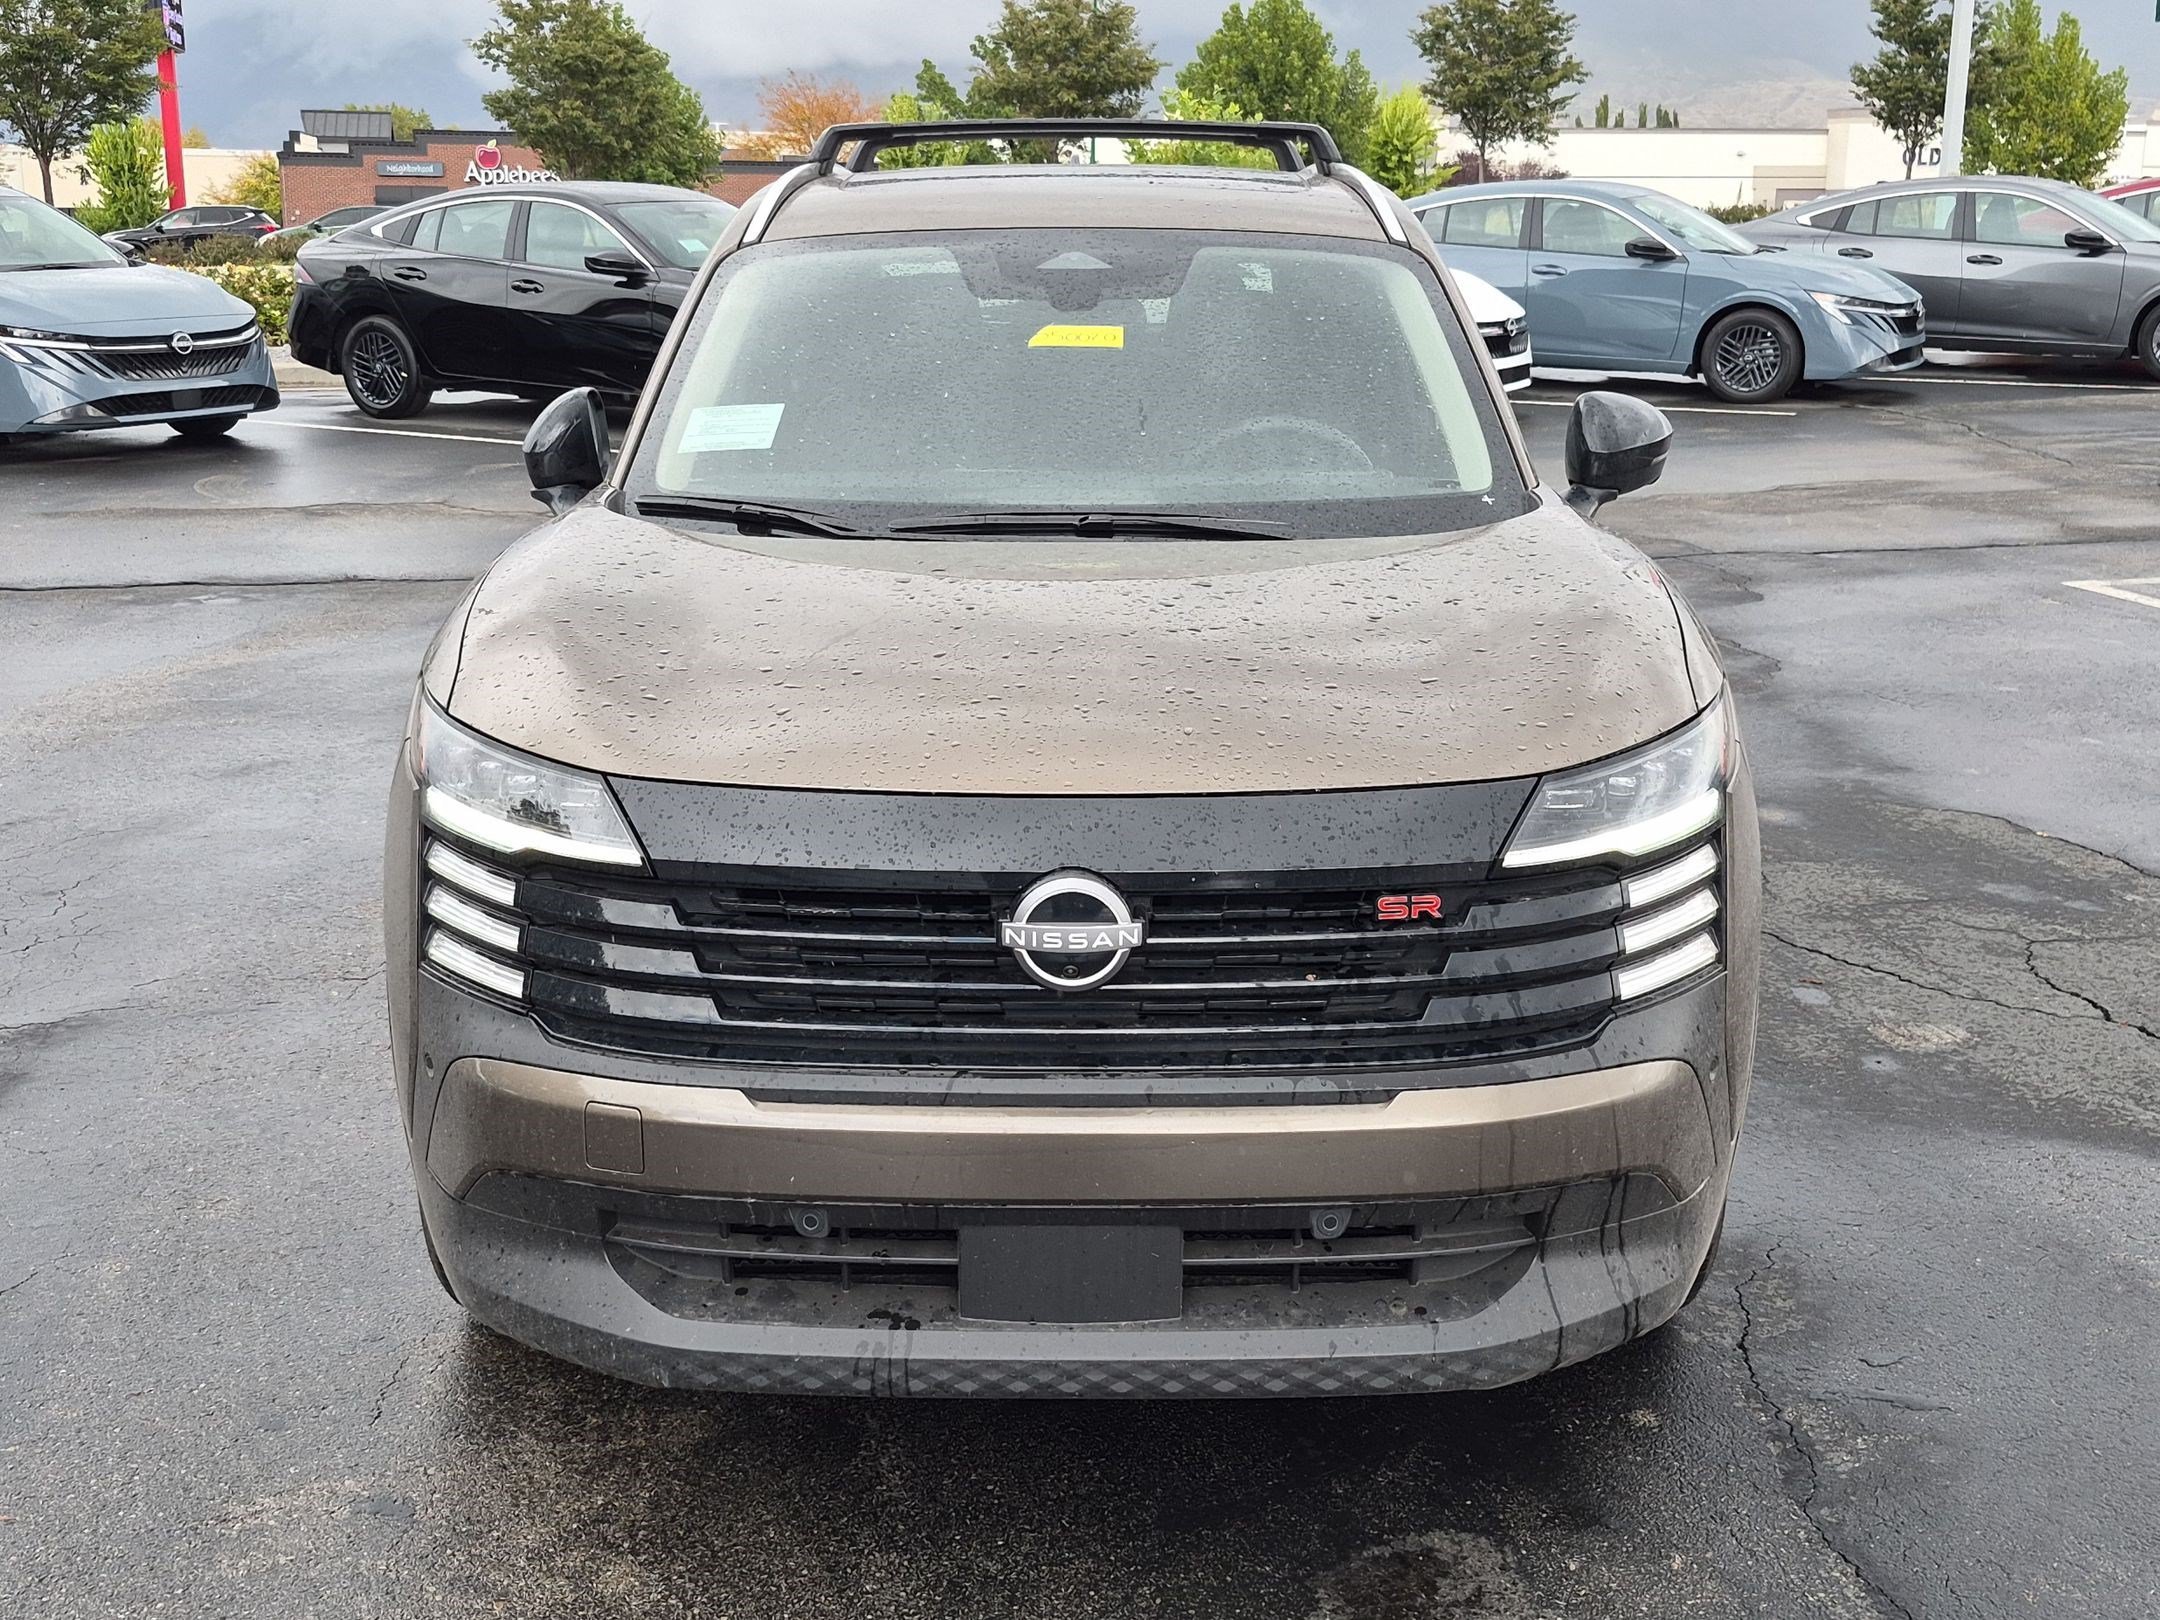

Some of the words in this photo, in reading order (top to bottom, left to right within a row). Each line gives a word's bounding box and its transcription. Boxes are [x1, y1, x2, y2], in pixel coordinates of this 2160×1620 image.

[1902, 147, 1942, 166] OLD
[1377, 894, 1442, 920] SR
[1005, 927, 1139, 949] NISSAN
